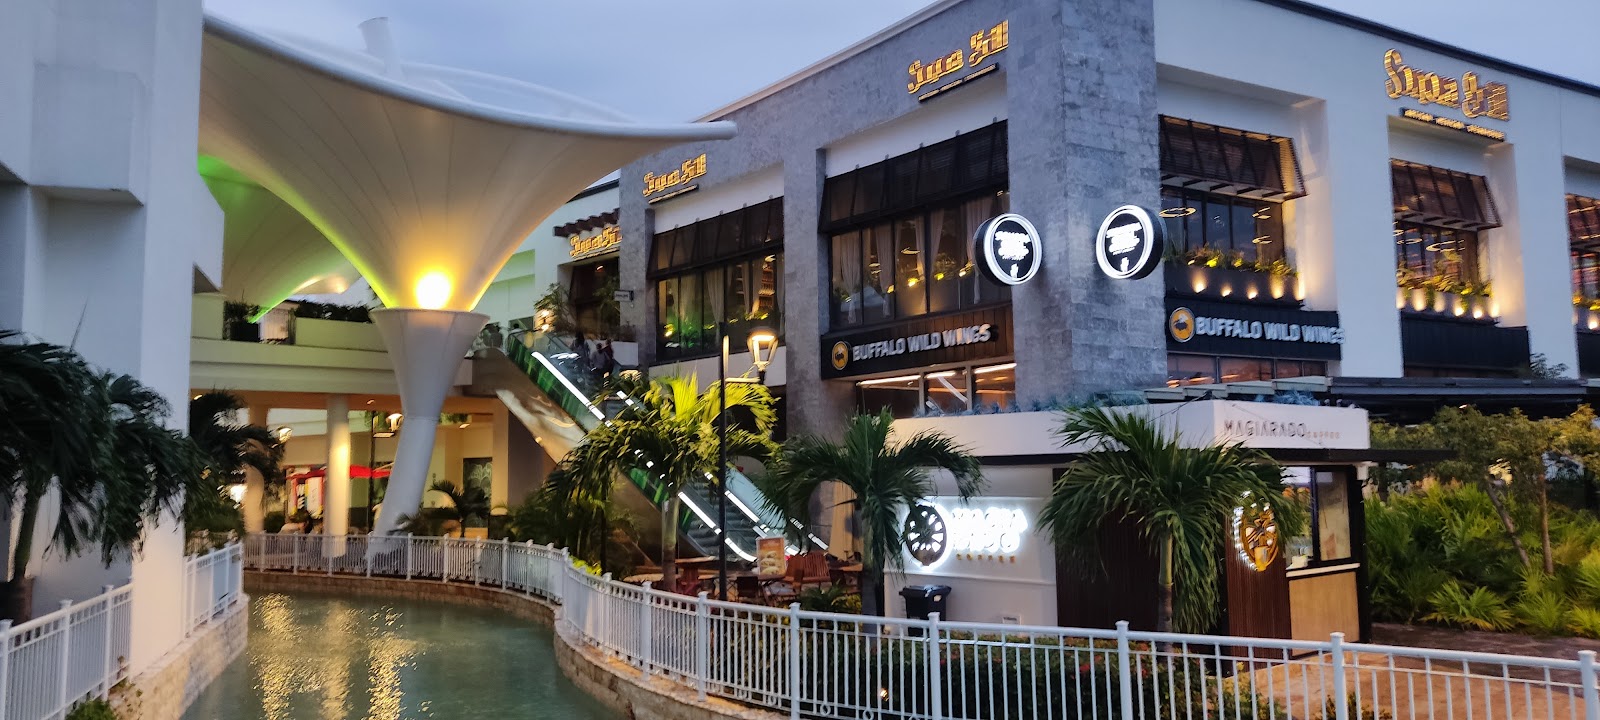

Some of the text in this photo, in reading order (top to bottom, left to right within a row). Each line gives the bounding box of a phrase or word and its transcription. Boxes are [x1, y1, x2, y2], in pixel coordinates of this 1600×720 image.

[852, 323, 992, 362] BUFFALO WILD WINGS
[1195, 316, 1346, 344] BUFFALO WILD WINGS
